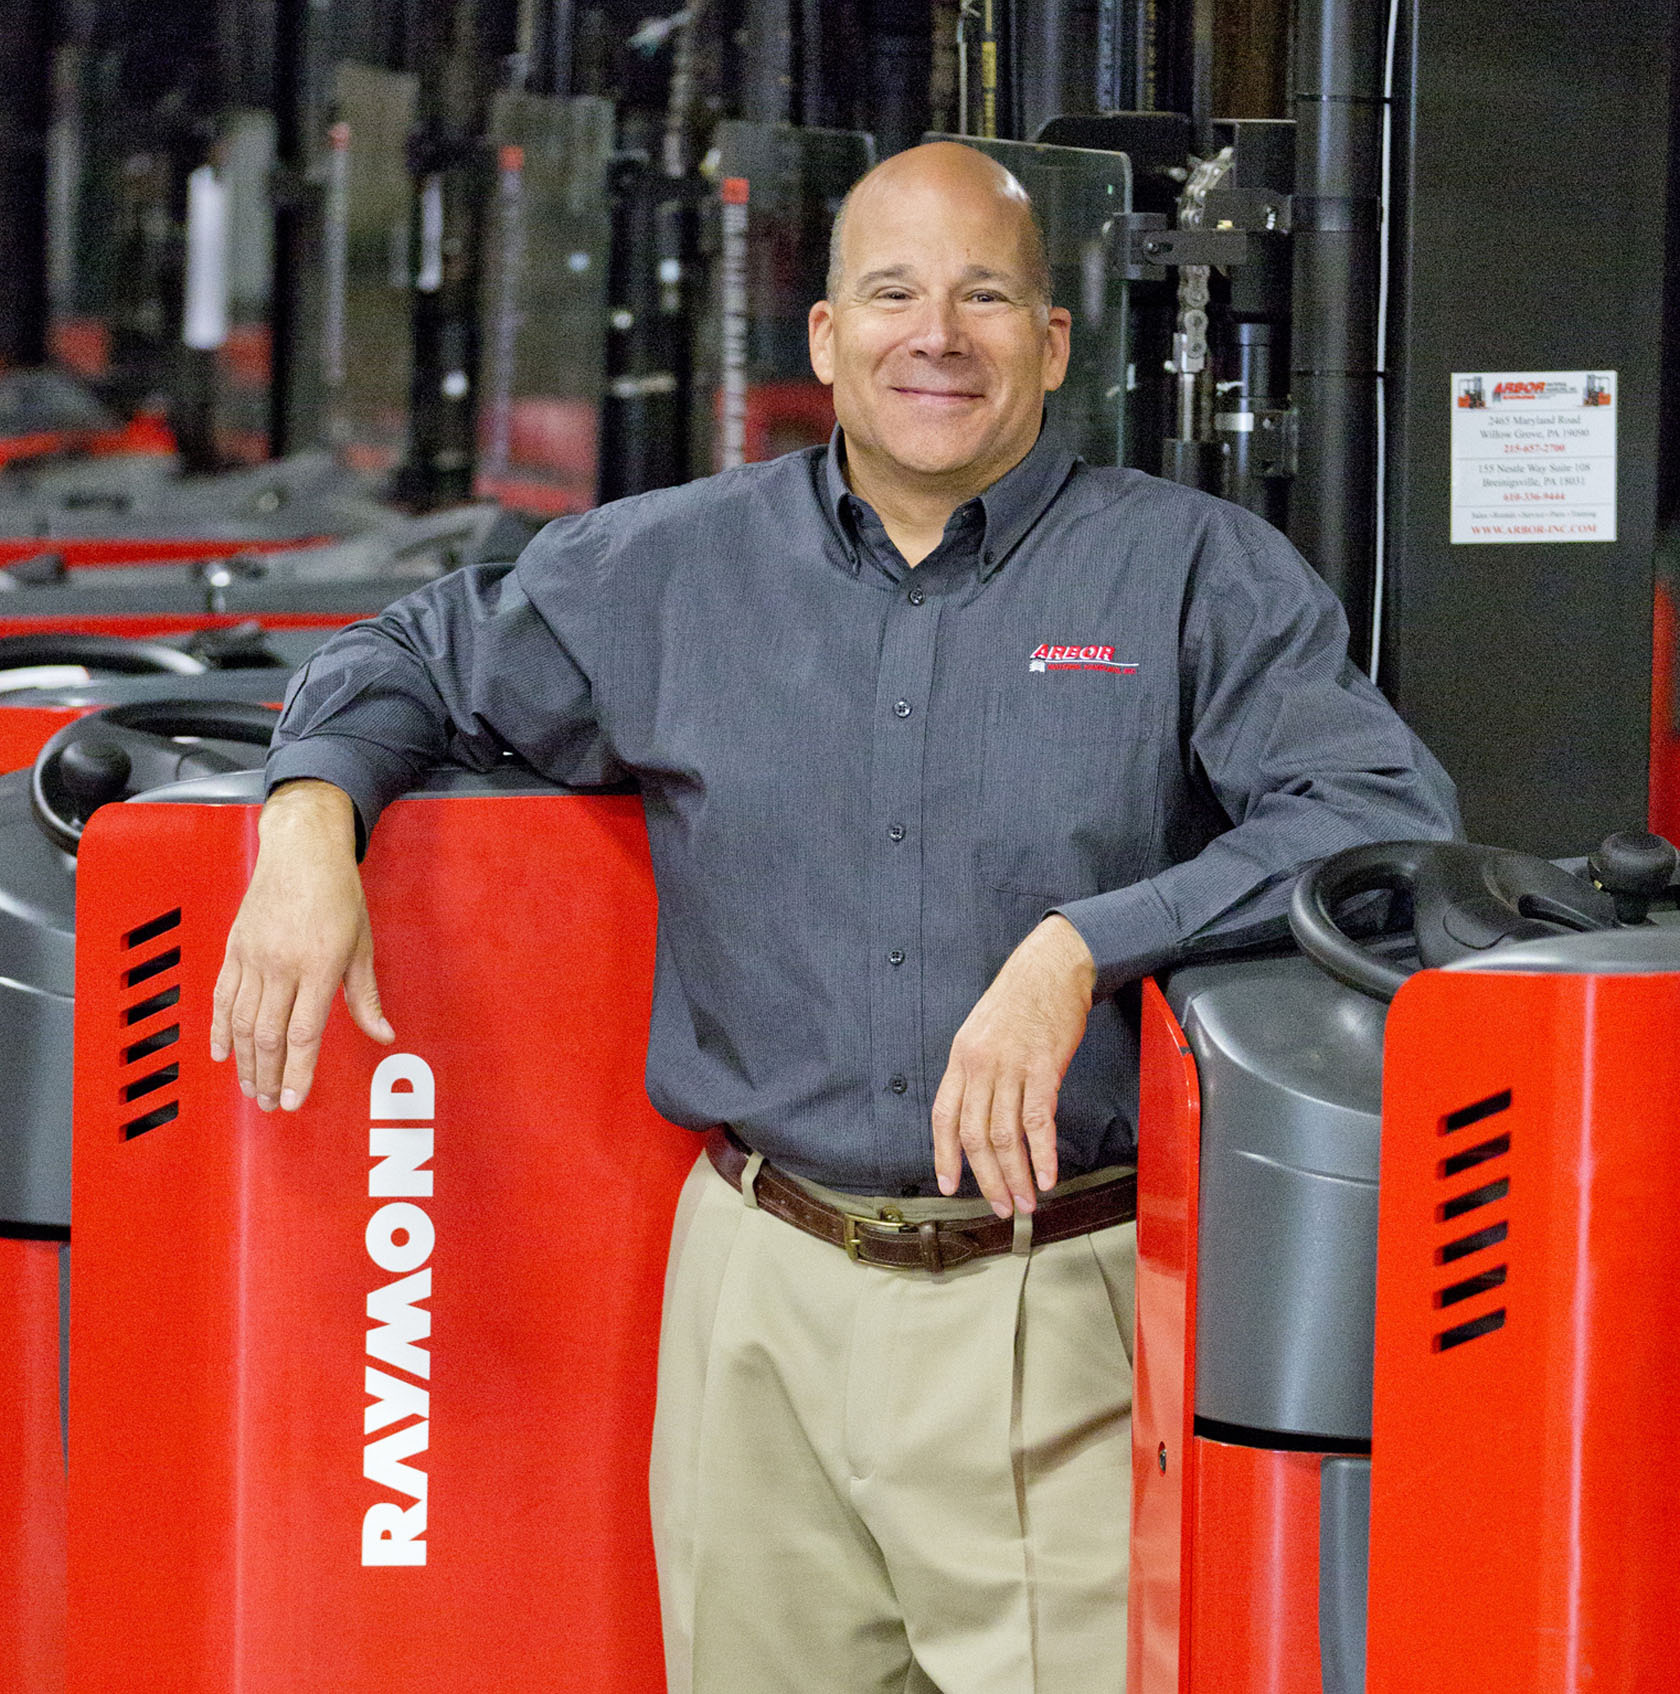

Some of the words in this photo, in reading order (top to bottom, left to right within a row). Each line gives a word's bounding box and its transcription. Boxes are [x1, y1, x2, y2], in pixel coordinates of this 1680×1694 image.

[1493, 382, 1546, 393] ARBOR
[1512, 415, 1555, 427] Maryland
[1558, 415, 1581, 425] Road
[1480, 430, 1511, 439] Willow
[1547, 429, 1559, 438] PA
[1528, 463, 1546, 475] Way
[1549, 463, 1571, 472] Suite
[1544, 477, 1556, 486] PA
[1472, 524, 1597, 536] WWW.ARBOR-INC.COM
[1030, 643, 1116, 661] ARBOR
[361, 1053, 435, 1567] RAYMOND
